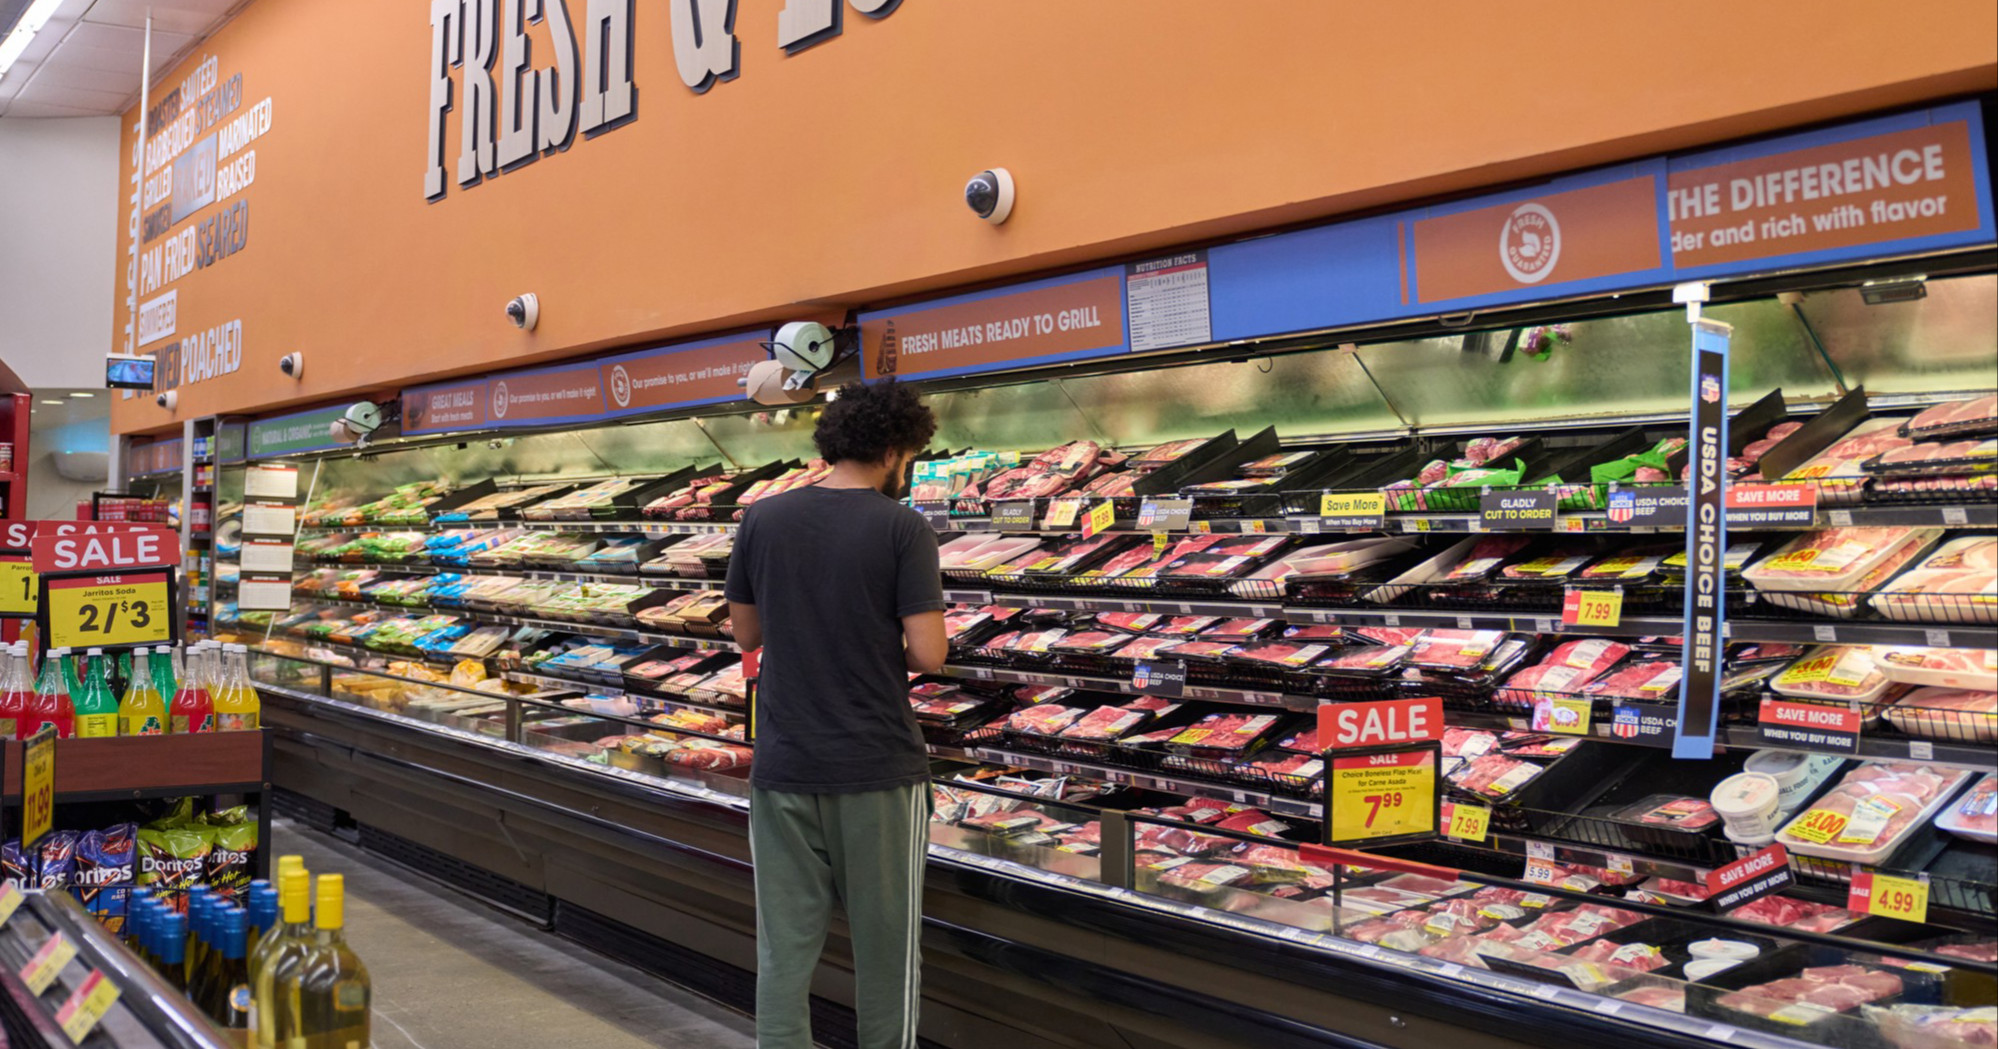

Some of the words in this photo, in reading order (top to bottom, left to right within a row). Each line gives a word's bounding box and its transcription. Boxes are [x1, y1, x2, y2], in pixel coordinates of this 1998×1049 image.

[196, 72, 242, 136] STEAMED
[218, 96, 272, 162] MARINATED
[146, 108, 195, 177] BARBEQUED
[216, 150, 256, 202] BRAISED
[1668, 183, 1720, 222] THE
[1731, 144, 1945, 212] DIFFERENCE
[144, 164, 172, 211] GRILLED
[1512, 214, 1545, 234] FRESH
[1710, 218, 1756, 250] and
[1762, 214, 1805, 240] rich
[1814, 203, 1864, 232] with
[1870, 194, 1947, 226] flavor
[197, 198, 248, 270] SEARED
[140, 244, 162, 297] PAN
[164, 225, 196, 284] FRIED
[1136, 258, 1172, 274] NUTRITION
[1174, 254, 1196, 266] FACTS
[902, 332, 938, 356] FRESH
[941, 324, 983, 350] MEATS
[986, 316, 1030, 342] READY
[1034, 312, 1054, 336] TO
[1057, 306, 1100, 332] GRILL
[180, 318, 242, 386] POACHED
[1701, 427, 1718, 495] USDA
[1327, 500, 1350, 511] Save
[1352, 500, 1378, 510] More
[1501, 498, 1536, 508] GLADLY
[1635, 498, 1658, 506] USDA
[1736, 490, 1764, 503] SAVE
[1766, 489, 1800, 502] MORE
[1485, 510, 1503, 520] CUT
[1505, 510, 1518, 519] TO
[1519, 509, 1552, 519] ORDER
[1635, 507, 1656, 516] BEEF
[1726, 513, 1748, 522] WHEN
[1750, 512, 1766, 521] YOU
[1768, 512, 1784, 521] BUY
[1785, 511, 1809, 520] MORE
[54, 535, 160, 568] SALE
[1698, 502, 1716, 608] CHOICE
[96, 576, 122, 584] SALE
[82, 589, 114, 598] Jarritos
[1584, 602, 1610, 620] 7.99
[1694, 616, 1712, 672] BEEF
[1337, 704, 1428, 744] SALE
[1640, 716, 1664, 726] USDA
[1776, 708, 1806, 722] SAVE
[1808, 710, 1844, 726] MORE
[1640, 726, 1662, 735] BEEF
[1764, 728, 1788, 739] WHEN
[1789, 731, 1808, 742] YOU
[1808, 734, 1826, 744] BUY
[1826, 736, 1852, 747] MORE
[1369, 754, 1398, 764] SALE
[28, 784, 50, 834] 11.99
[1456, 816, 1479, 836] 7.99
[142, 854, 203, 872] Doritos
[1528, 866, 1550, 880] 5.99
[1720, 866, 1745, 885] SAVE
[1744, 852, 1774, 874] MORE
[1718, 892, 1740, 907] WHEN
[1738, 886, 1754, 899] YOU
[1754, 880, 1768, 893] BUY
[1767, 871, 1788, 887] MORE
[1850, 886, 1870, 897] SALE
[1878, 889, 1914, 913] 4.99
